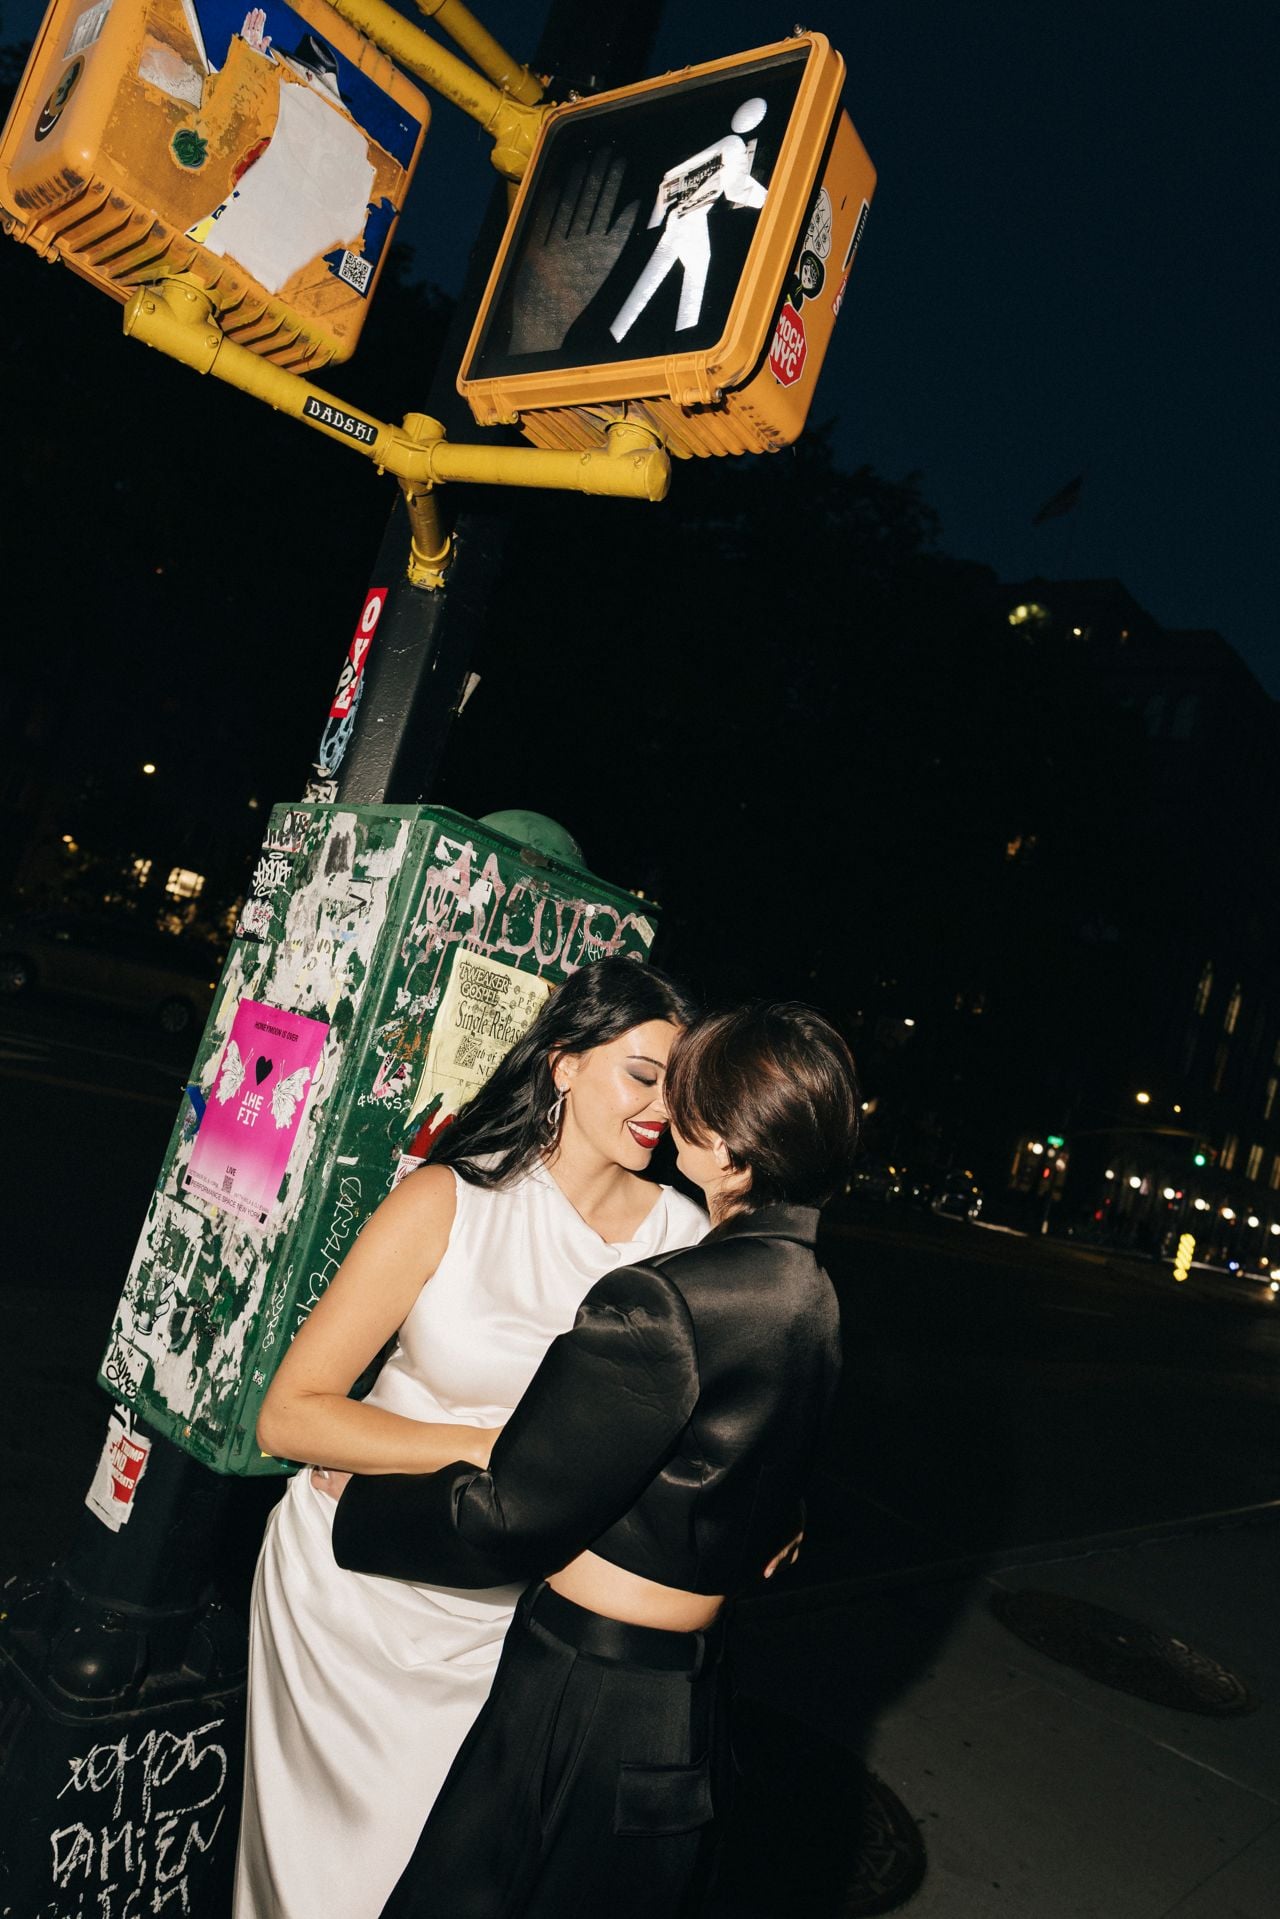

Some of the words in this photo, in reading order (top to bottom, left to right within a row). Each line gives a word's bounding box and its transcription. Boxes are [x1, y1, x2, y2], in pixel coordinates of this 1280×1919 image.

[770, 332, 798, 378] NYC
[307, 399, 374, 442] DADSKI
[459, 961, 511, 994] TWEAKER
[460, 980, 500, 1006] GOSPEL
[254, 1021, 282, 1037] HONEYMOON
[286, 1031, 299, 1042] OVER
[455, 999, 489, 1038] Single
[241, 1090, 264, 1111] THE
[236, 1107, 259, 1128] FIT
[225, 1165, 237, 1176] LIVE
